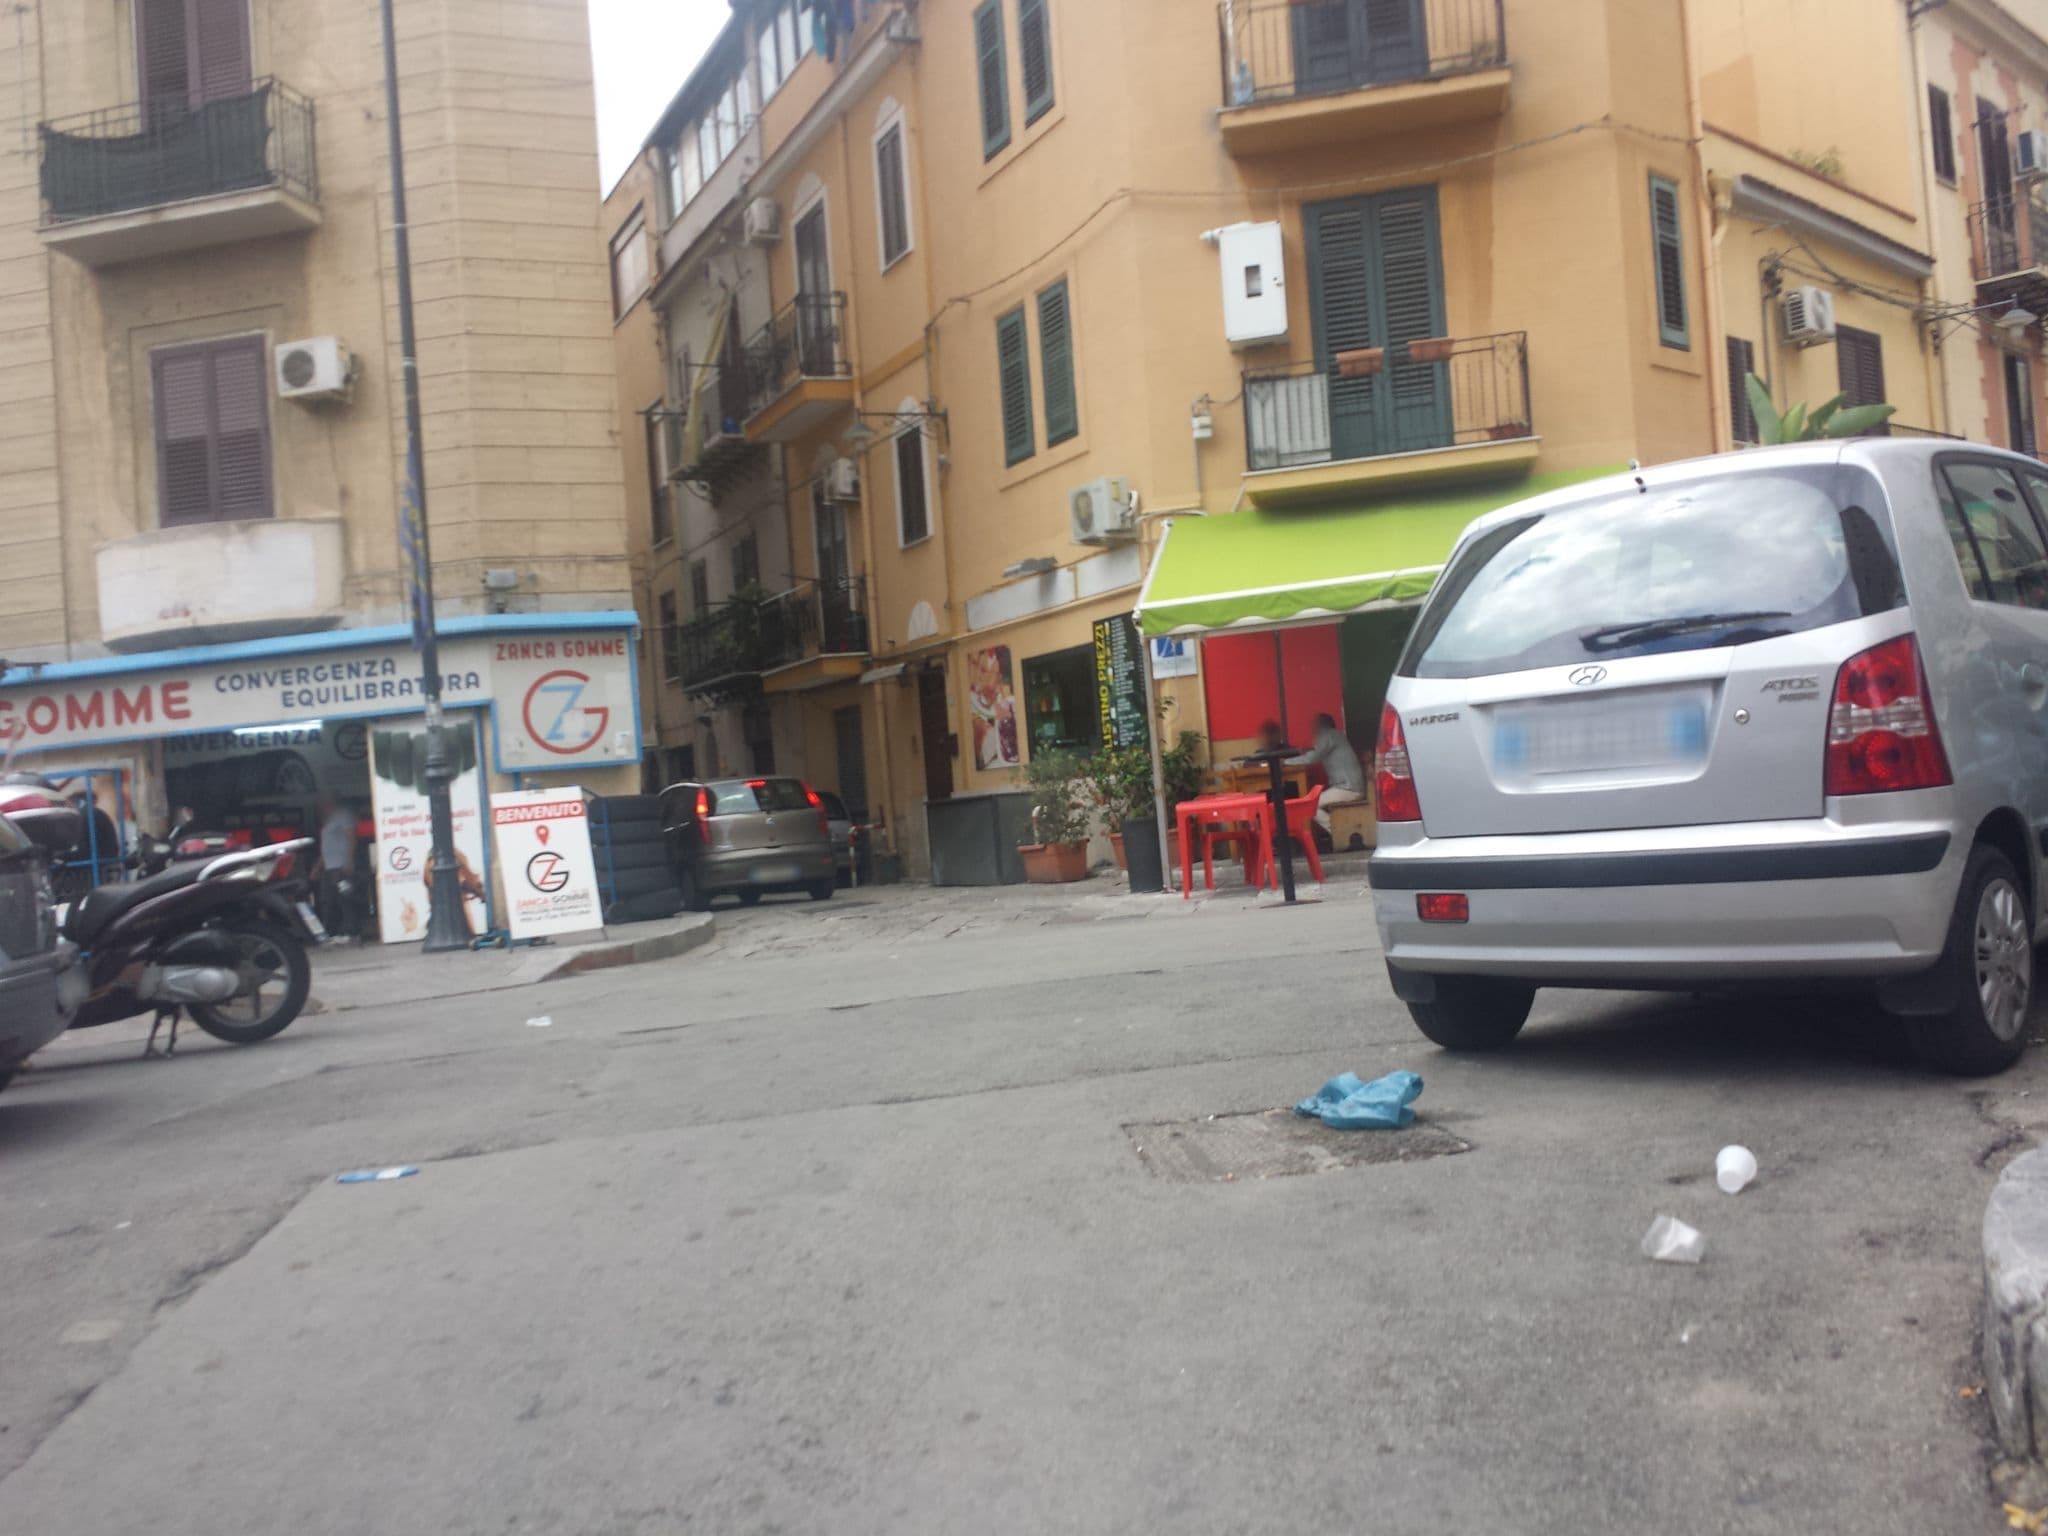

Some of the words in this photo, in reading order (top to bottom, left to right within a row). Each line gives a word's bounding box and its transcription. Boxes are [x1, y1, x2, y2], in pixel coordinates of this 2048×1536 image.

[496, 640, 556, 661] ZANCA
[563, 638, 625, 657] GOMME
[1095, 623, 1106, 681] PREZZI
[214, 657, 396, 693] CONVERGENZA
[0, 681, 192, 739] GOMME
[1100, 686, 1113, 750] LISTINO
[495, 802, 581, 821] BENVENUTO
